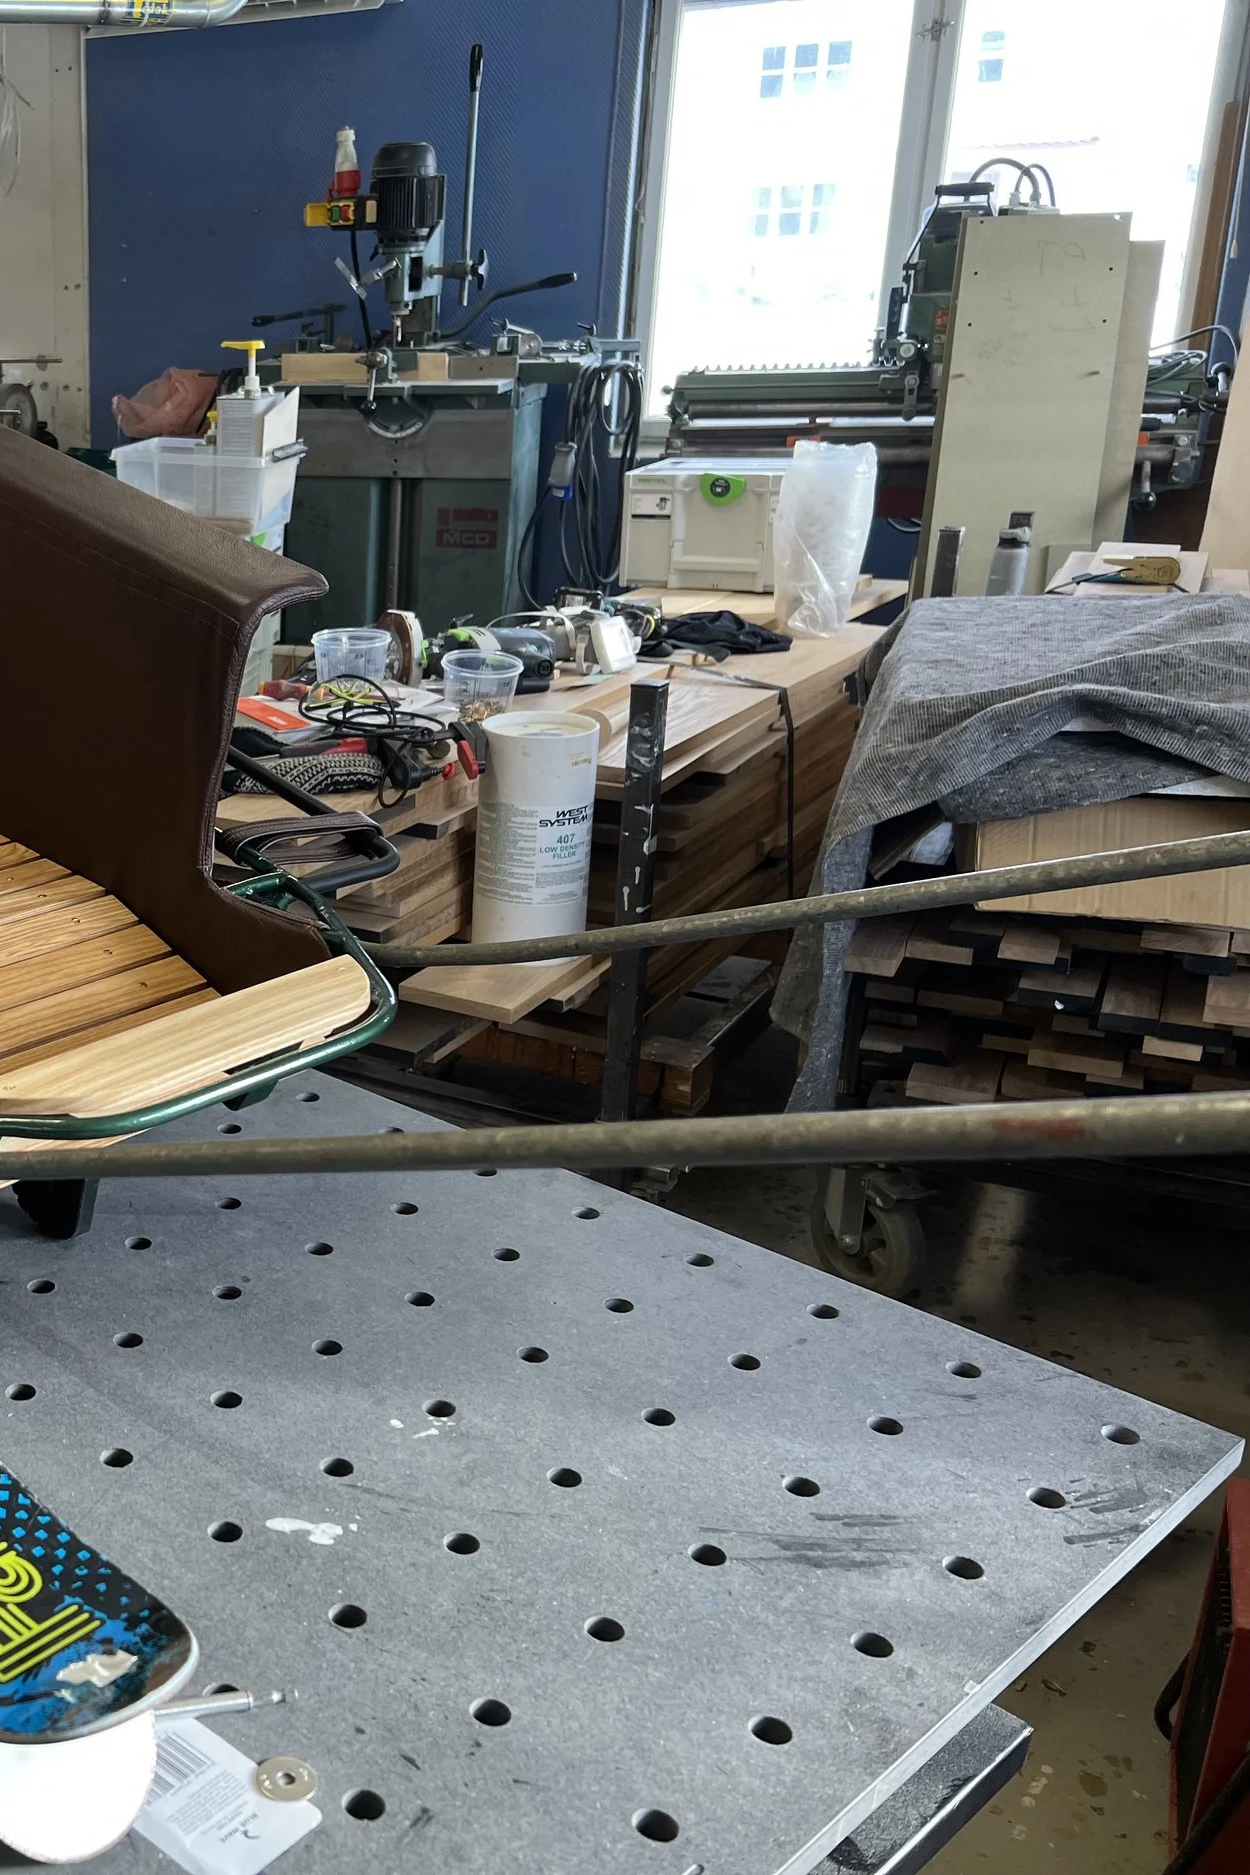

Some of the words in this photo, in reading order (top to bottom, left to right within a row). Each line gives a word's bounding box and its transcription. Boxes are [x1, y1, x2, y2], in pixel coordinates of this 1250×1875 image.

[556, 805, 588, 818] WEST
[539, 815, 588, 828] SYSTEM
[556, 834, 575, 844] 407
[539, 846, 558, 854] LOW
[559, 841, 585, 852] DENSITY
[552, 851, 576, 860] FILLER
